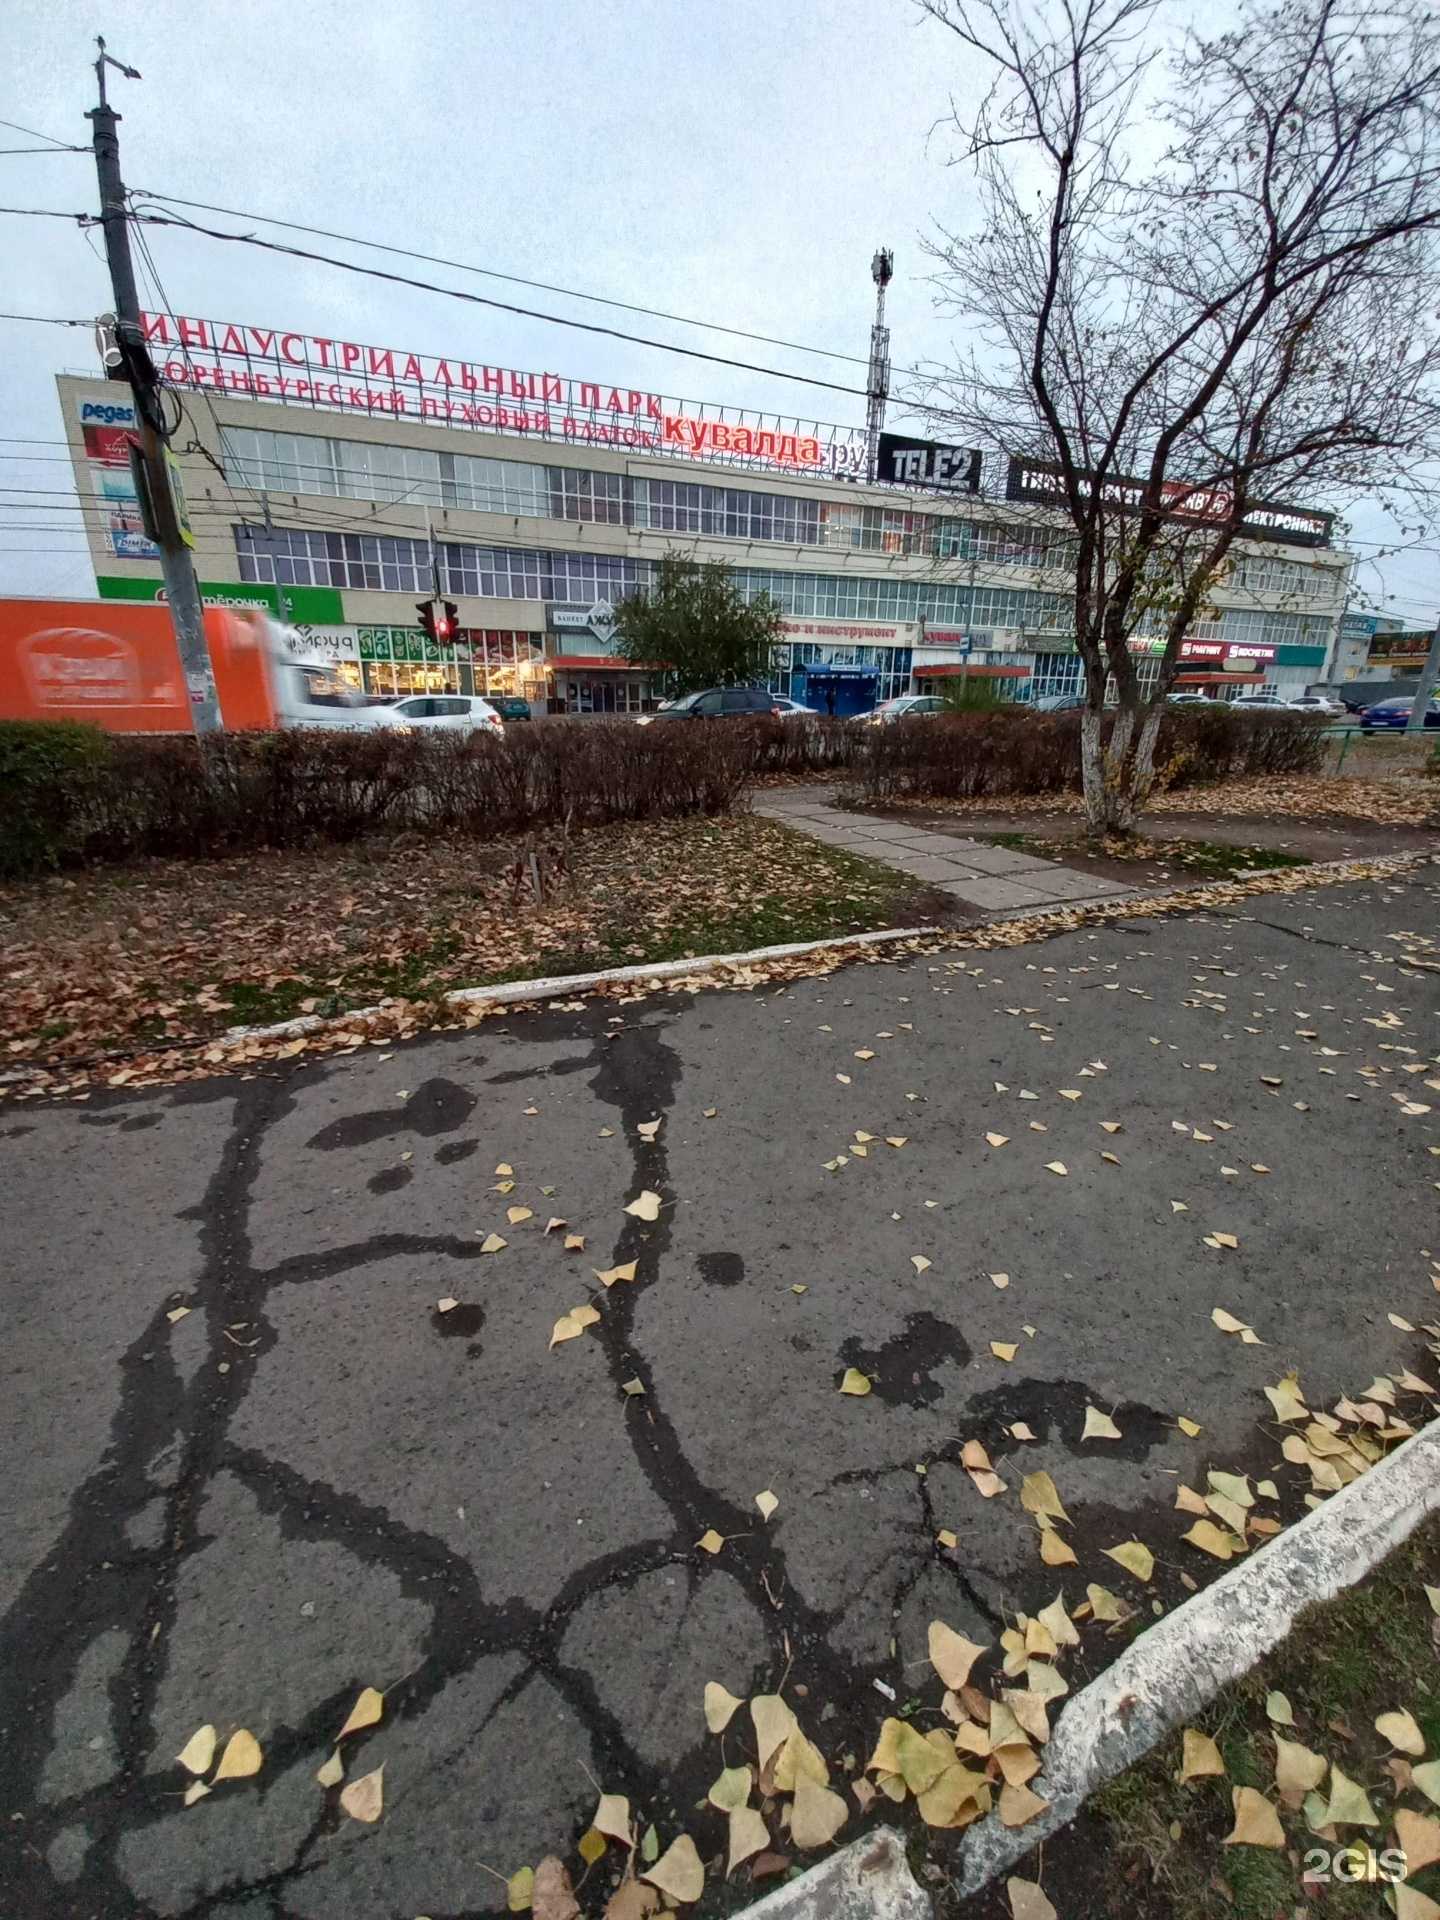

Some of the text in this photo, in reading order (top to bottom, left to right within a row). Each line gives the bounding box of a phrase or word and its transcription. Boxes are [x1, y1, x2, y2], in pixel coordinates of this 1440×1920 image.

[138, 311, 662, 420] ИНДУСТРИАЛЬНЫЙ ПАРК
[82, 403, 134, 424] pegas
[164, 361, 405, 413] ОРЕНБУРГСКИЙ
[422, 396, 551, 432] ПУХОВЫЙ
[892, 449, 973, 485] TELE2
[1243, 509, 1327, 536] ЛЕКТРОНИКИ
